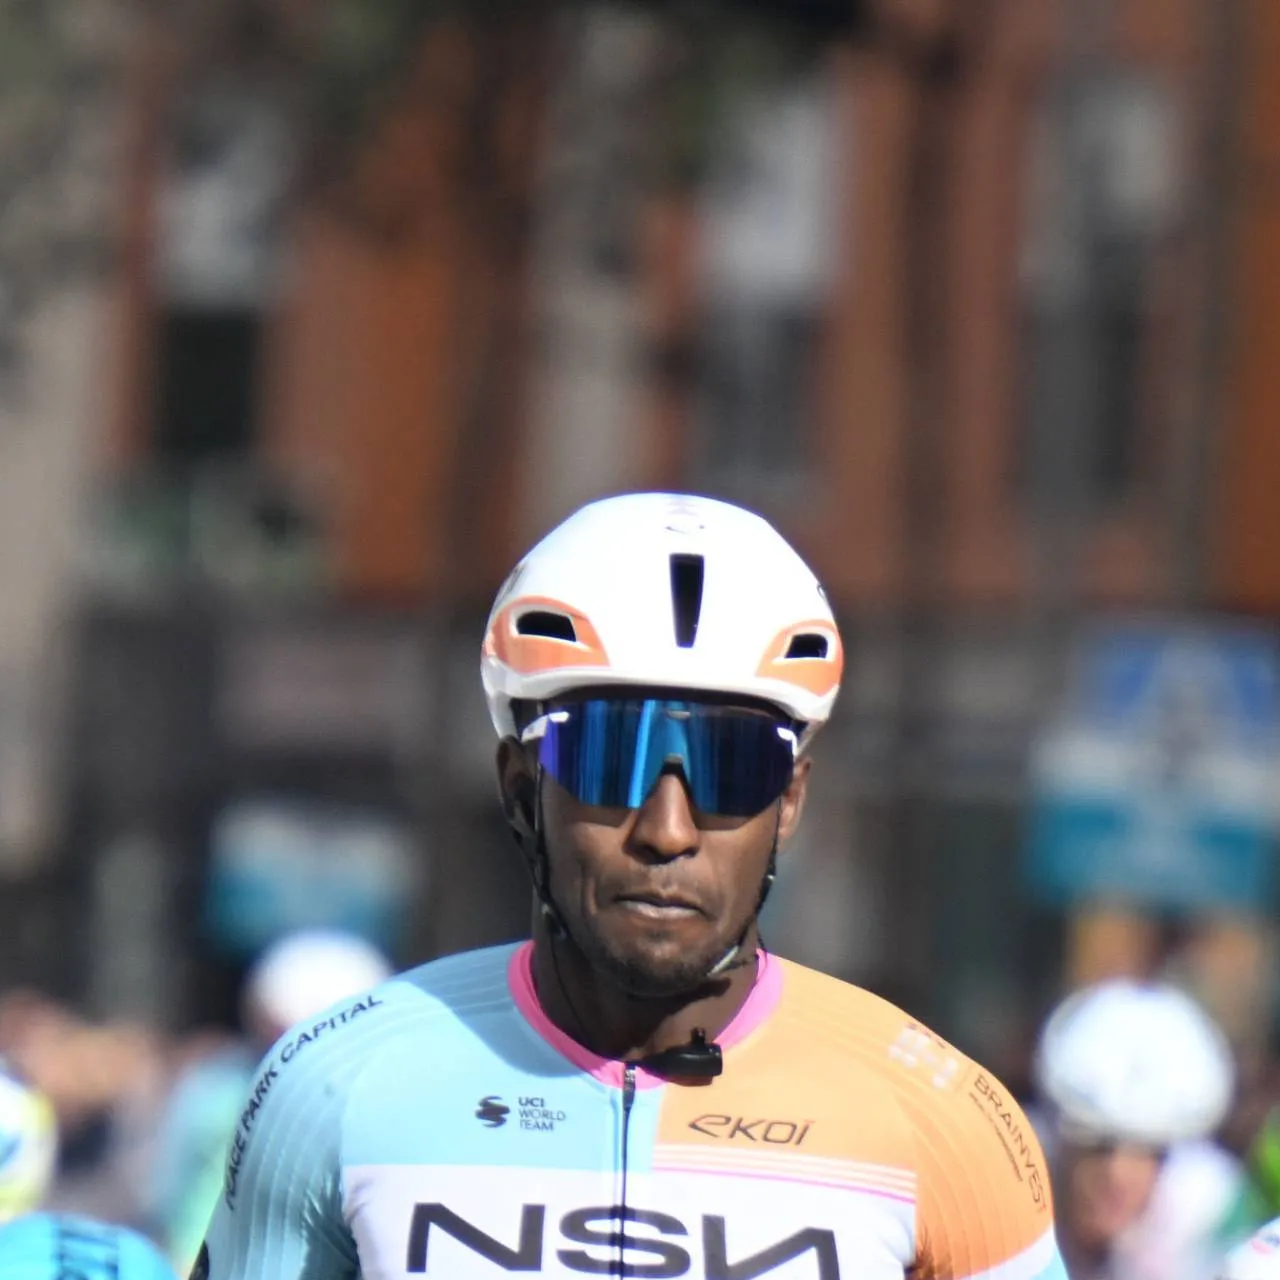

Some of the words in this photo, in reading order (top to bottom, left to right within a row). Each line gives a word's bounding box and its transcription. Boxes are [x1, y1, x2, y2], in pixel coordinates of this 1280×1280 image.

[241, 1062, 278, 1131] PARK
[280, 995, 383, 1064] CAPITAL
[518, 1096, 545, 1107] UCI
[519, 1108, 566, 1121] WORLD
[519, 1120, 554, 1131] TEAM
[974, 1074, 1048, 1214] BRAINVEST
